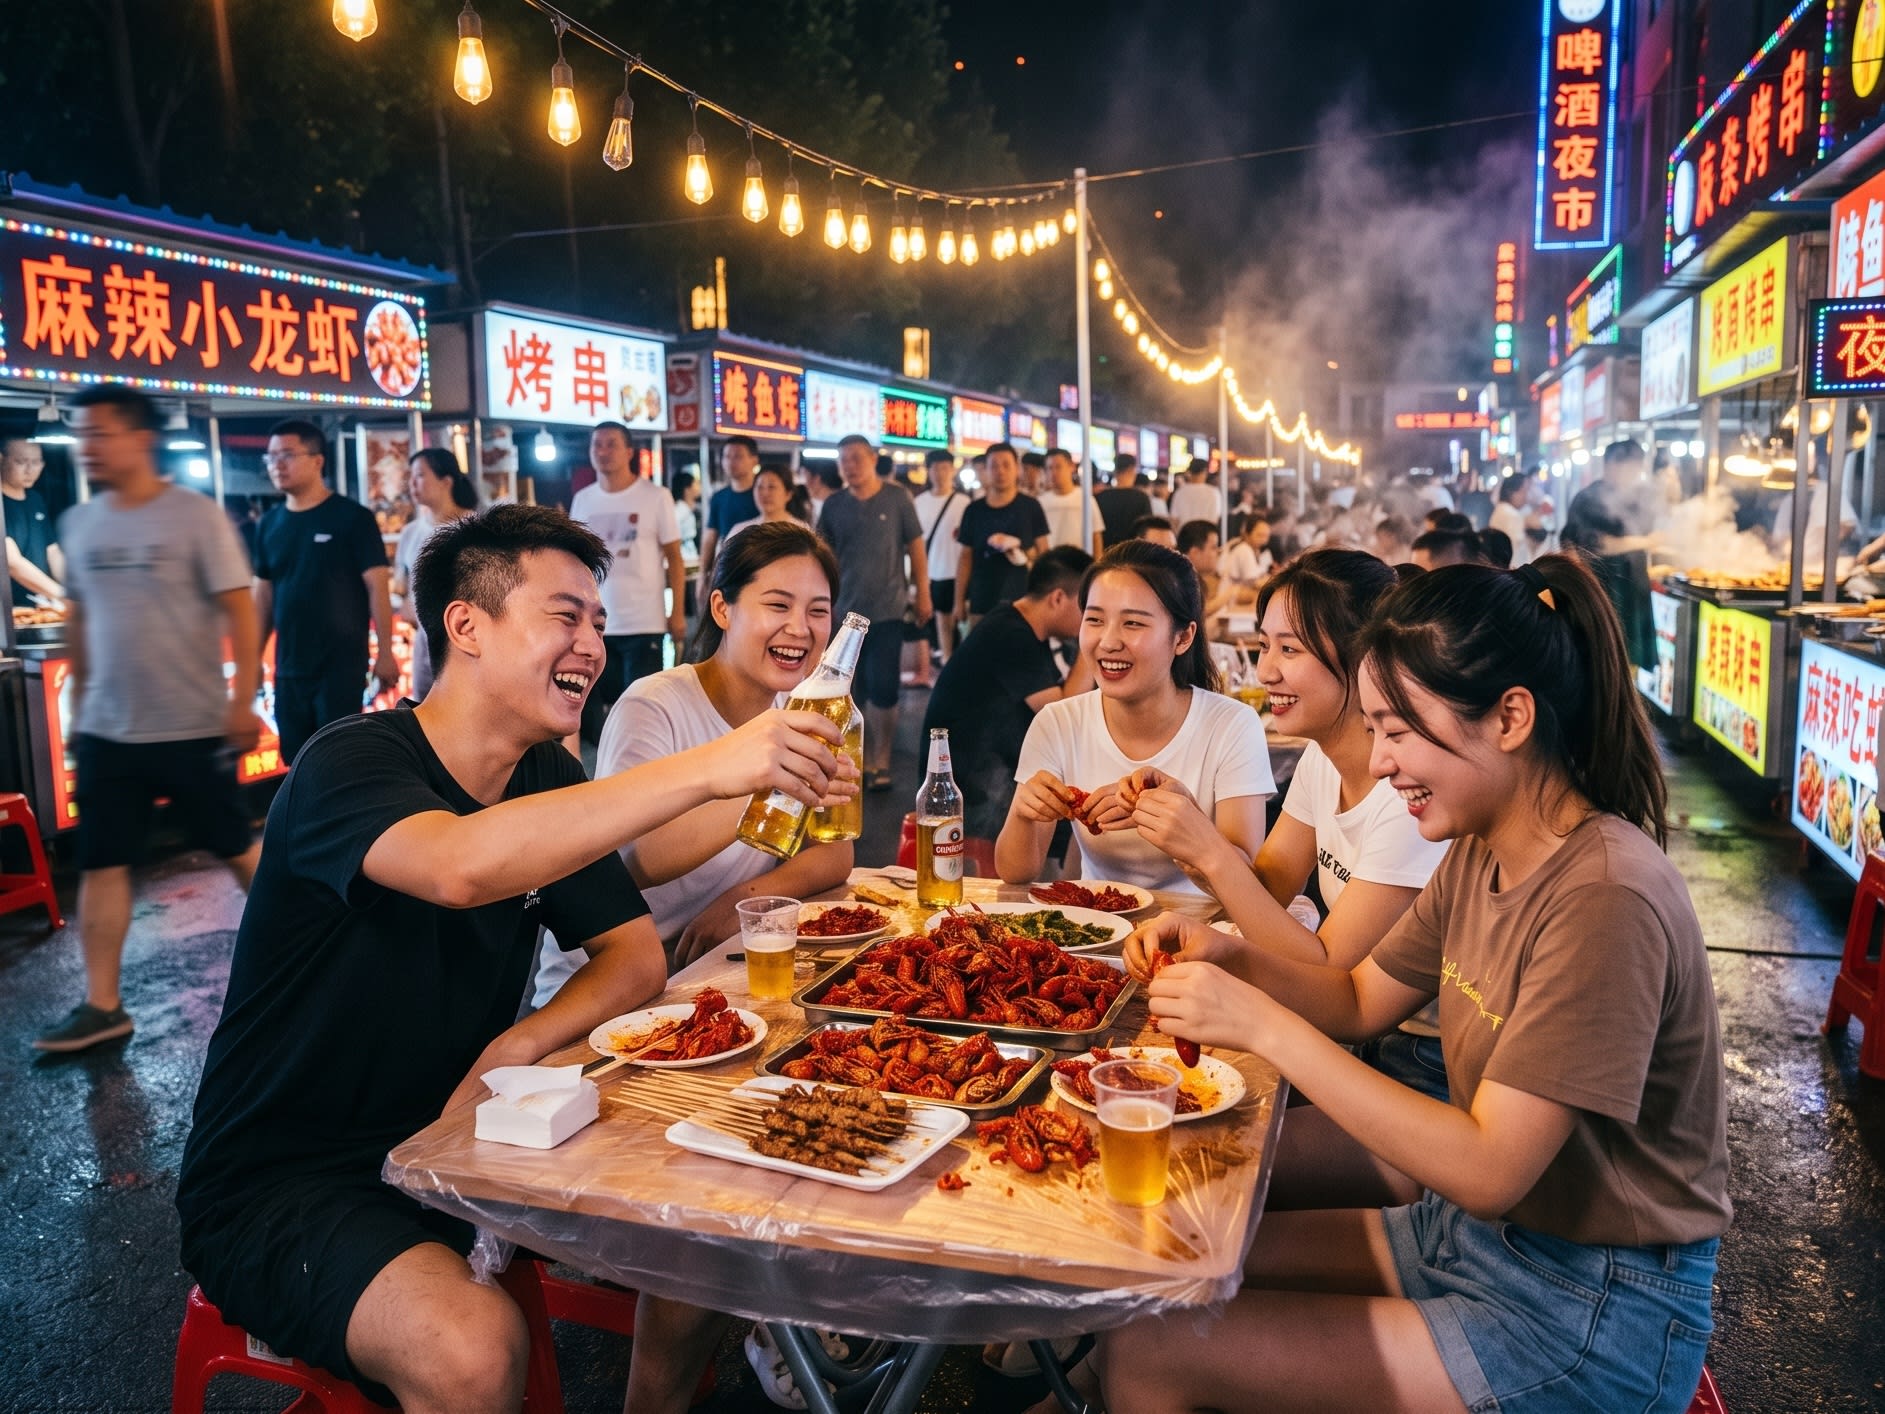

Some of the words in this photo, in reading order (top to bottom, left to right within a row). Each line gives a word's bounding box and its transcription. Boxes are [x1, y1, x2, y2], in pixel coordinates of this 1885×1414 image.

[1552, 28, 1602, 231] 啤酒夜市
[21, 255, 360, 382] 麻辣小龙虾
[1837, 315, 1885, 377] 夜
[504, 329, 609, 417] 烤串
